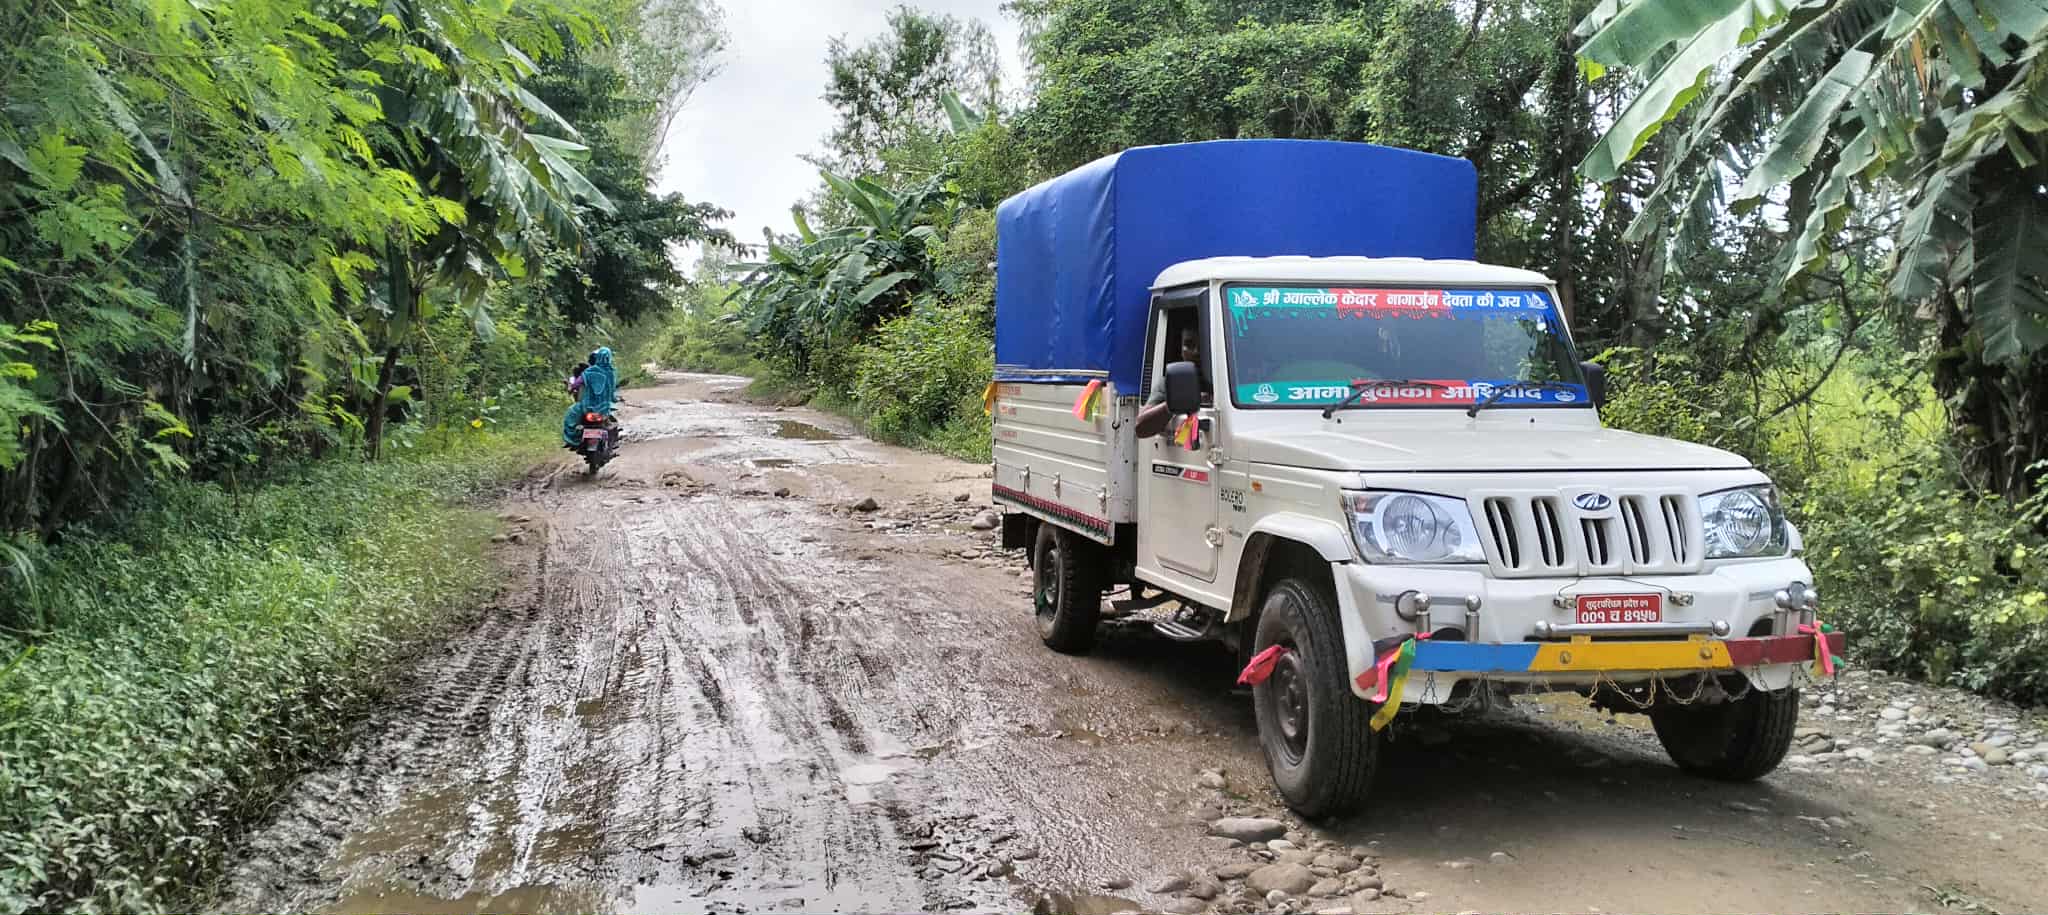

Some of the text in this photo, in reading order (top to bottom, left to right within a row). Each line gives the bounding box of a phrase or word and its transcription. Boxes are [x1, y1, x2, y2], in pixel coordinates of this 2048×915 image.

[1262, 289, 1521, 309] श्री ग्वाल्लेक केदार नागार्जुन देवता की जय
[1287, 385, 1350, 400] आमा
[1581, 611, 1606, 623] ००१
[1624, 610, 1657, 623] ४१५७
